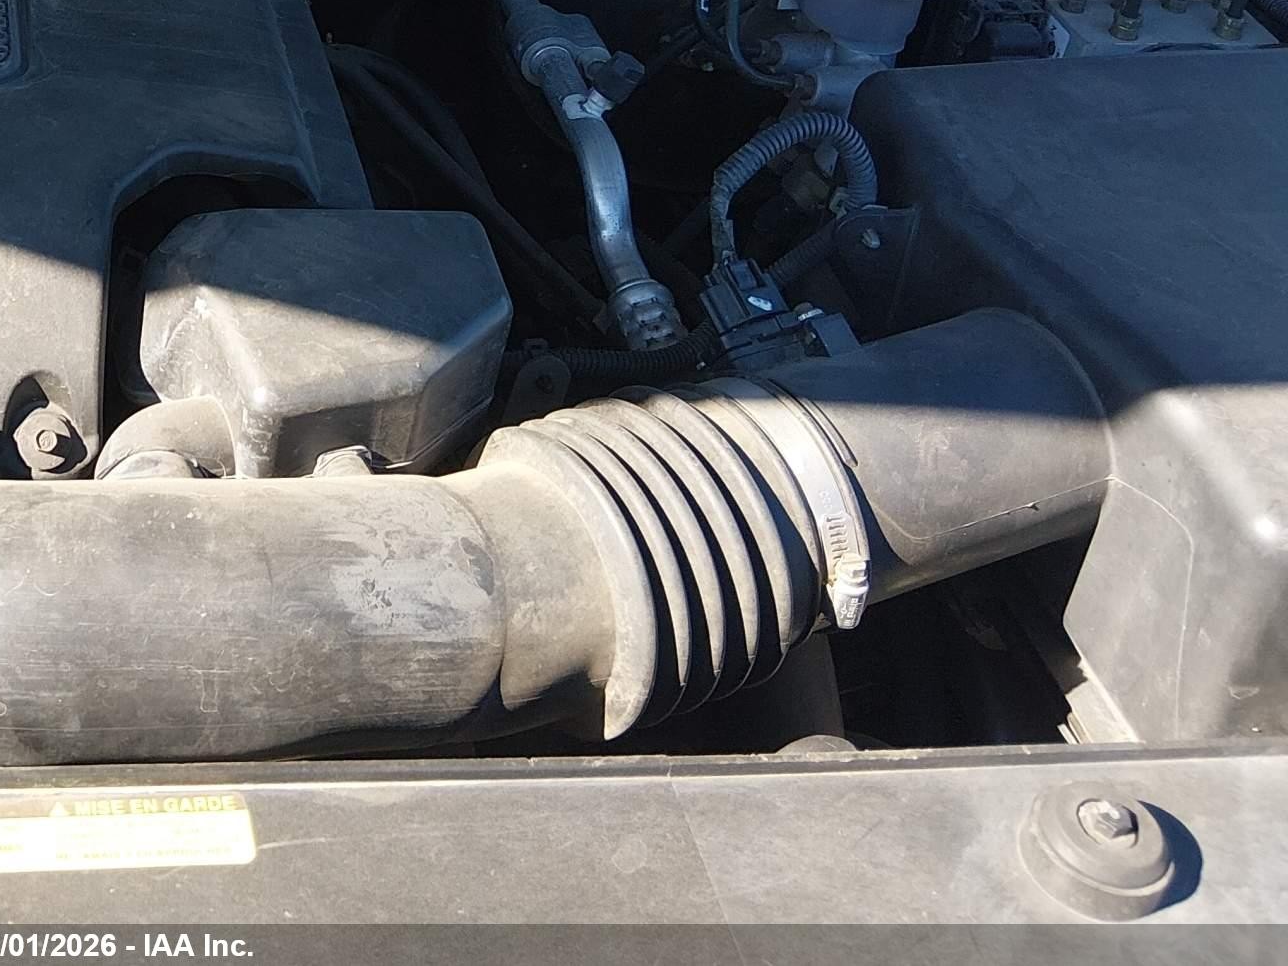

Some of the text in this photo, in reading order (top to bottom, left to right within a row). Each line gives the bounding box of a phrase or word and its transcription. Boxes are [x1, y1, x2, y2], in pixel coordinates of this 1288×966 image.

[74, 794, 236, 815] MISE EN GARDE
